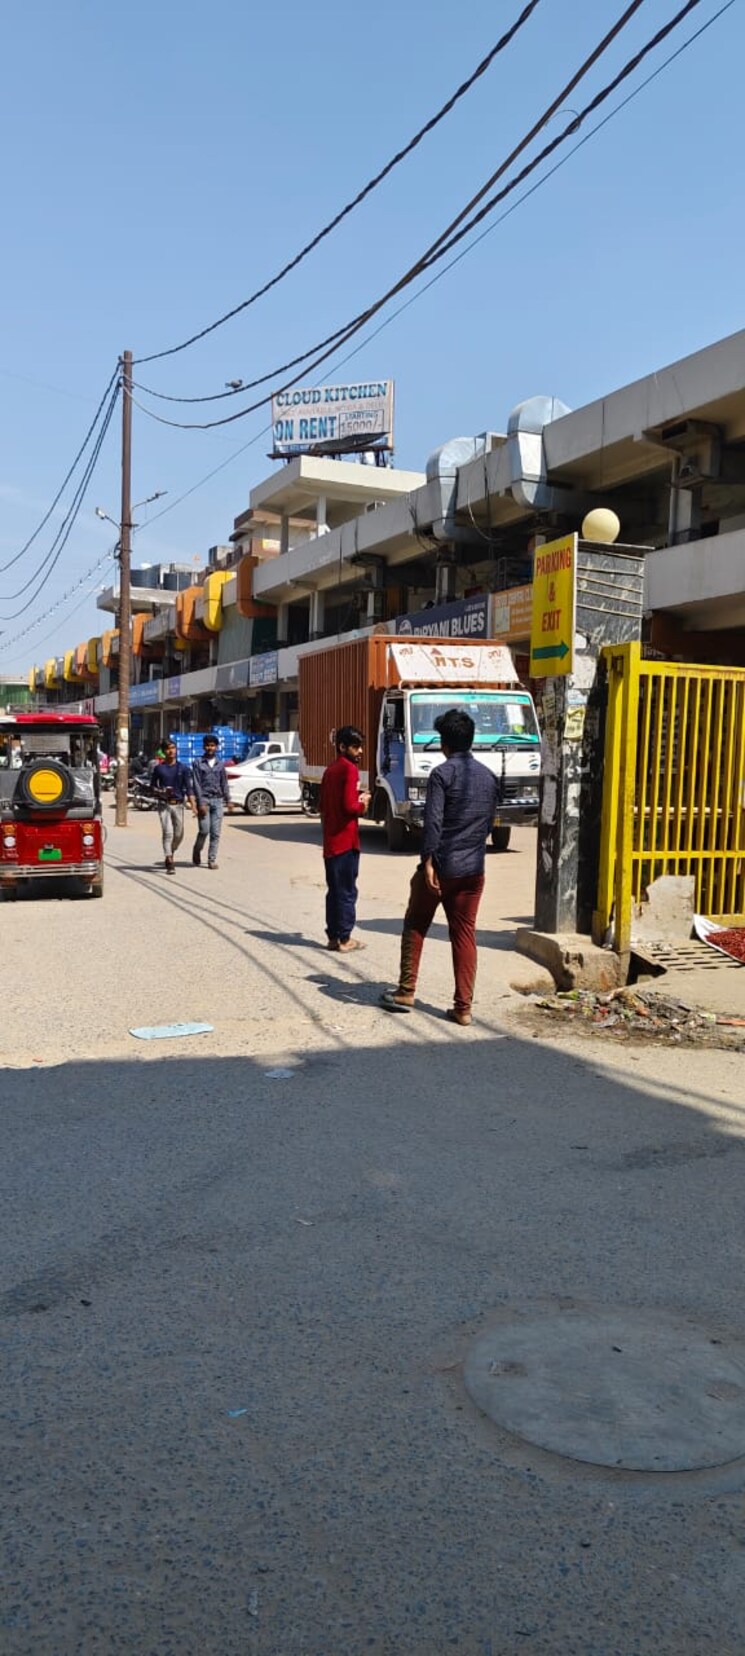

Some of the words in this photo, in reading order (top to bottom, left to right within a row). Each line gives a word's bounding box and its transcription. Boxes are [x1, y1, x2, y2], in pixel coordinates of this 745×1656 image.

[276, 390, 321, 407] CLOUD
[324, 383, 388, 402] KITCHEN
[275, 420, 294, 441] ON
[299, 416, 336, 439] RENT
[536, 547, 572, 576] PARKING
[548, 582, 556, 602] &
[451, 611, 485, 637] BLUES
[541, 608, 562, 632] EXIT
